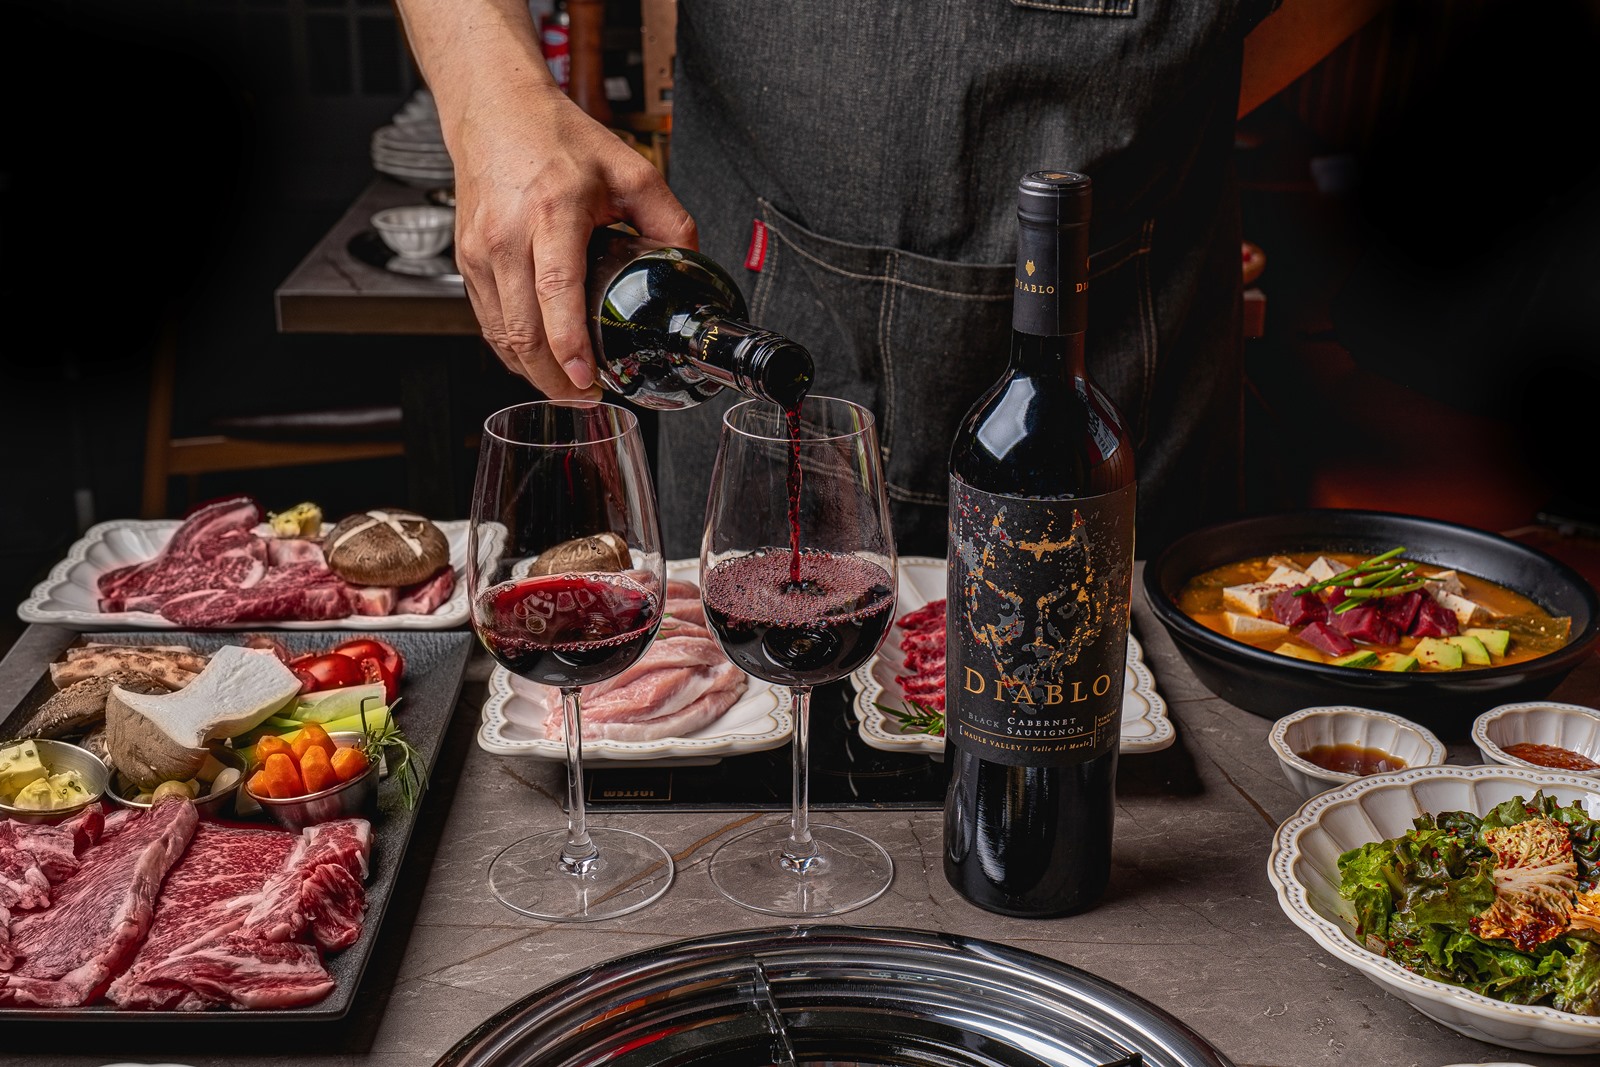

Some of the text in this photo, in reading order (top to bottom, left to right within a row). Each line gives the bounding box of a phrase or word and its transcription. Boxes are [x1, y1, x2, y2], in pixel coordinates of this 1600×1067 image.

[1015, 278, 1055, 294] DIABLO
[963, 665, 1111, 706] DIABLO
[968, 712, 1000, 729] BLACK
[1007, 716, 1077, 727] CABERNET
[1006, 726, 1084, 737] SAUVIGNON
[989, 740, 1022, 751] VALLEY
